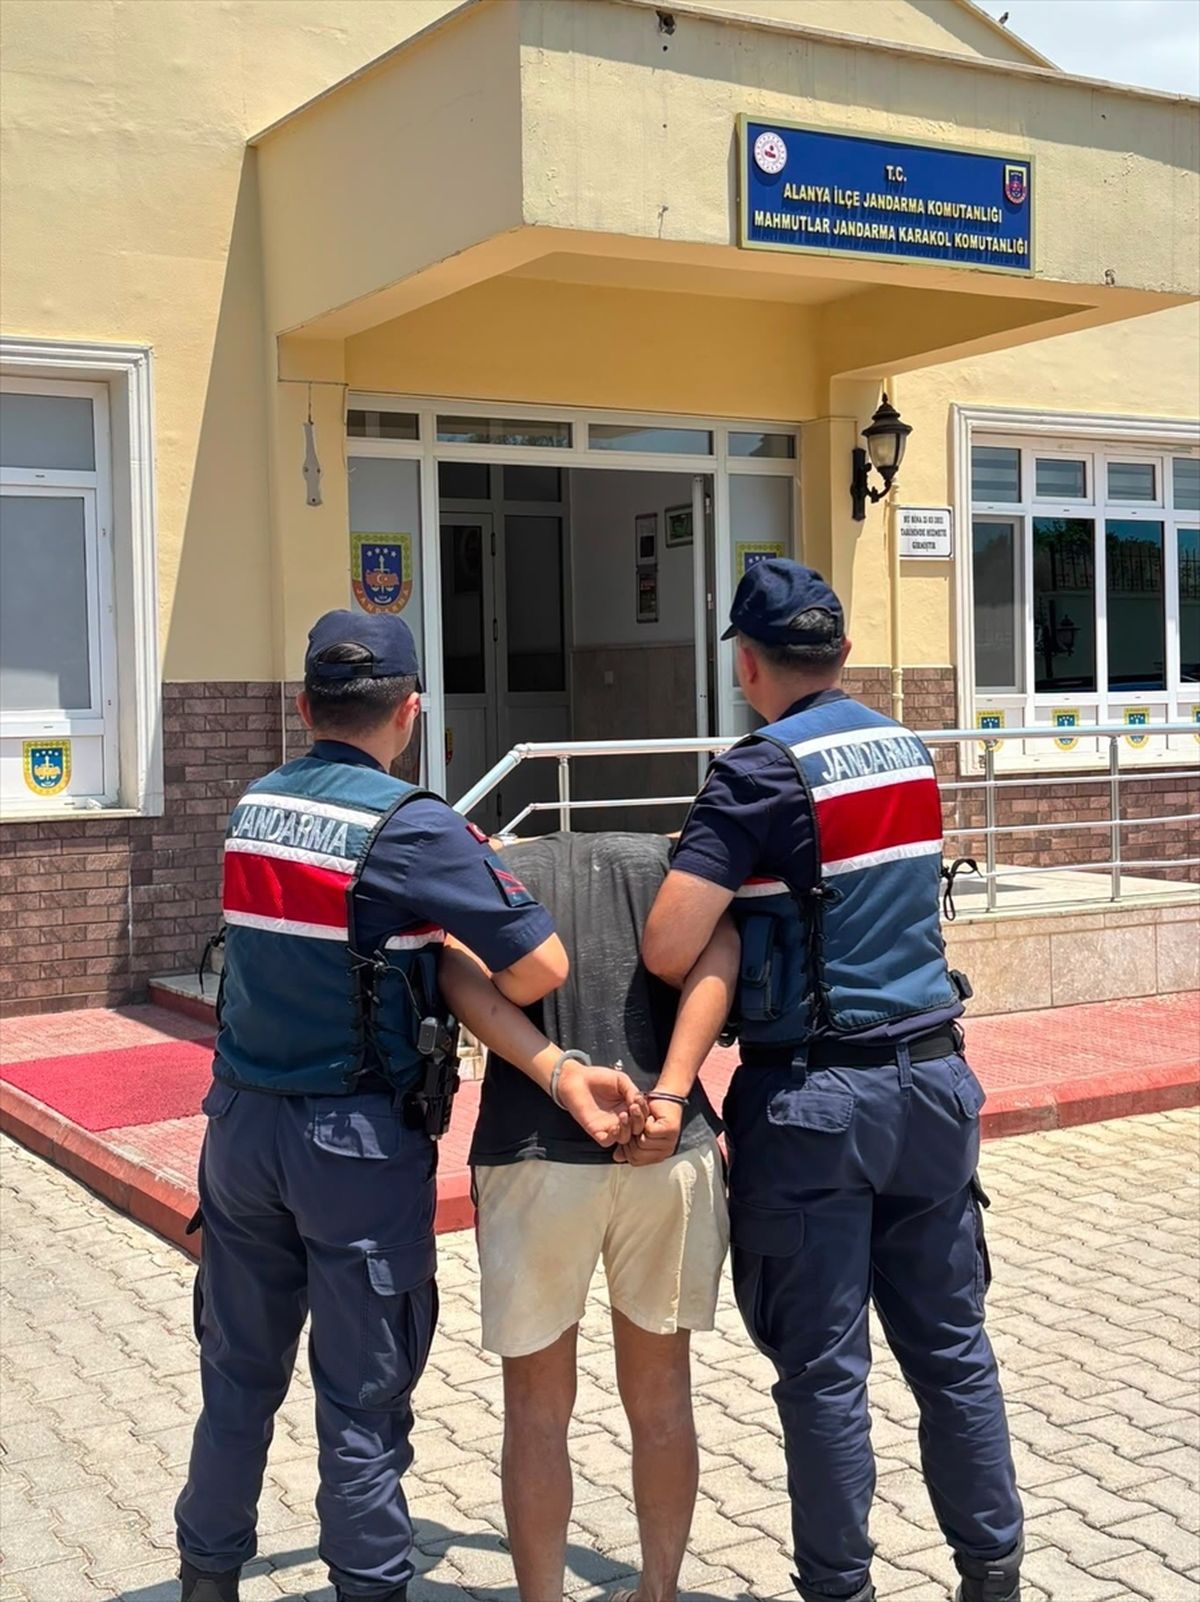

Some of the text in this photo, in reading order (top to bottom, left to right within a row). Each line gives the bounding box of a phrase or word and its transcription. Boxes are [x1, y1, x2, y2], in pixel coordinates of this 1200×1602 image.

[886, 165, 907, 181] T.C.
[784, 182, 1002, 223] ALANYA İLÇE JANDARMA KOMUTANLIĞI
[754, 210, 1028, 254] MAHMUTLAR JANDARMA KARAKOL KOMUTANLIĞI
[820, 736, 926, 782] JANDARMA
[232, 805, 349, 857] JANDARMA
